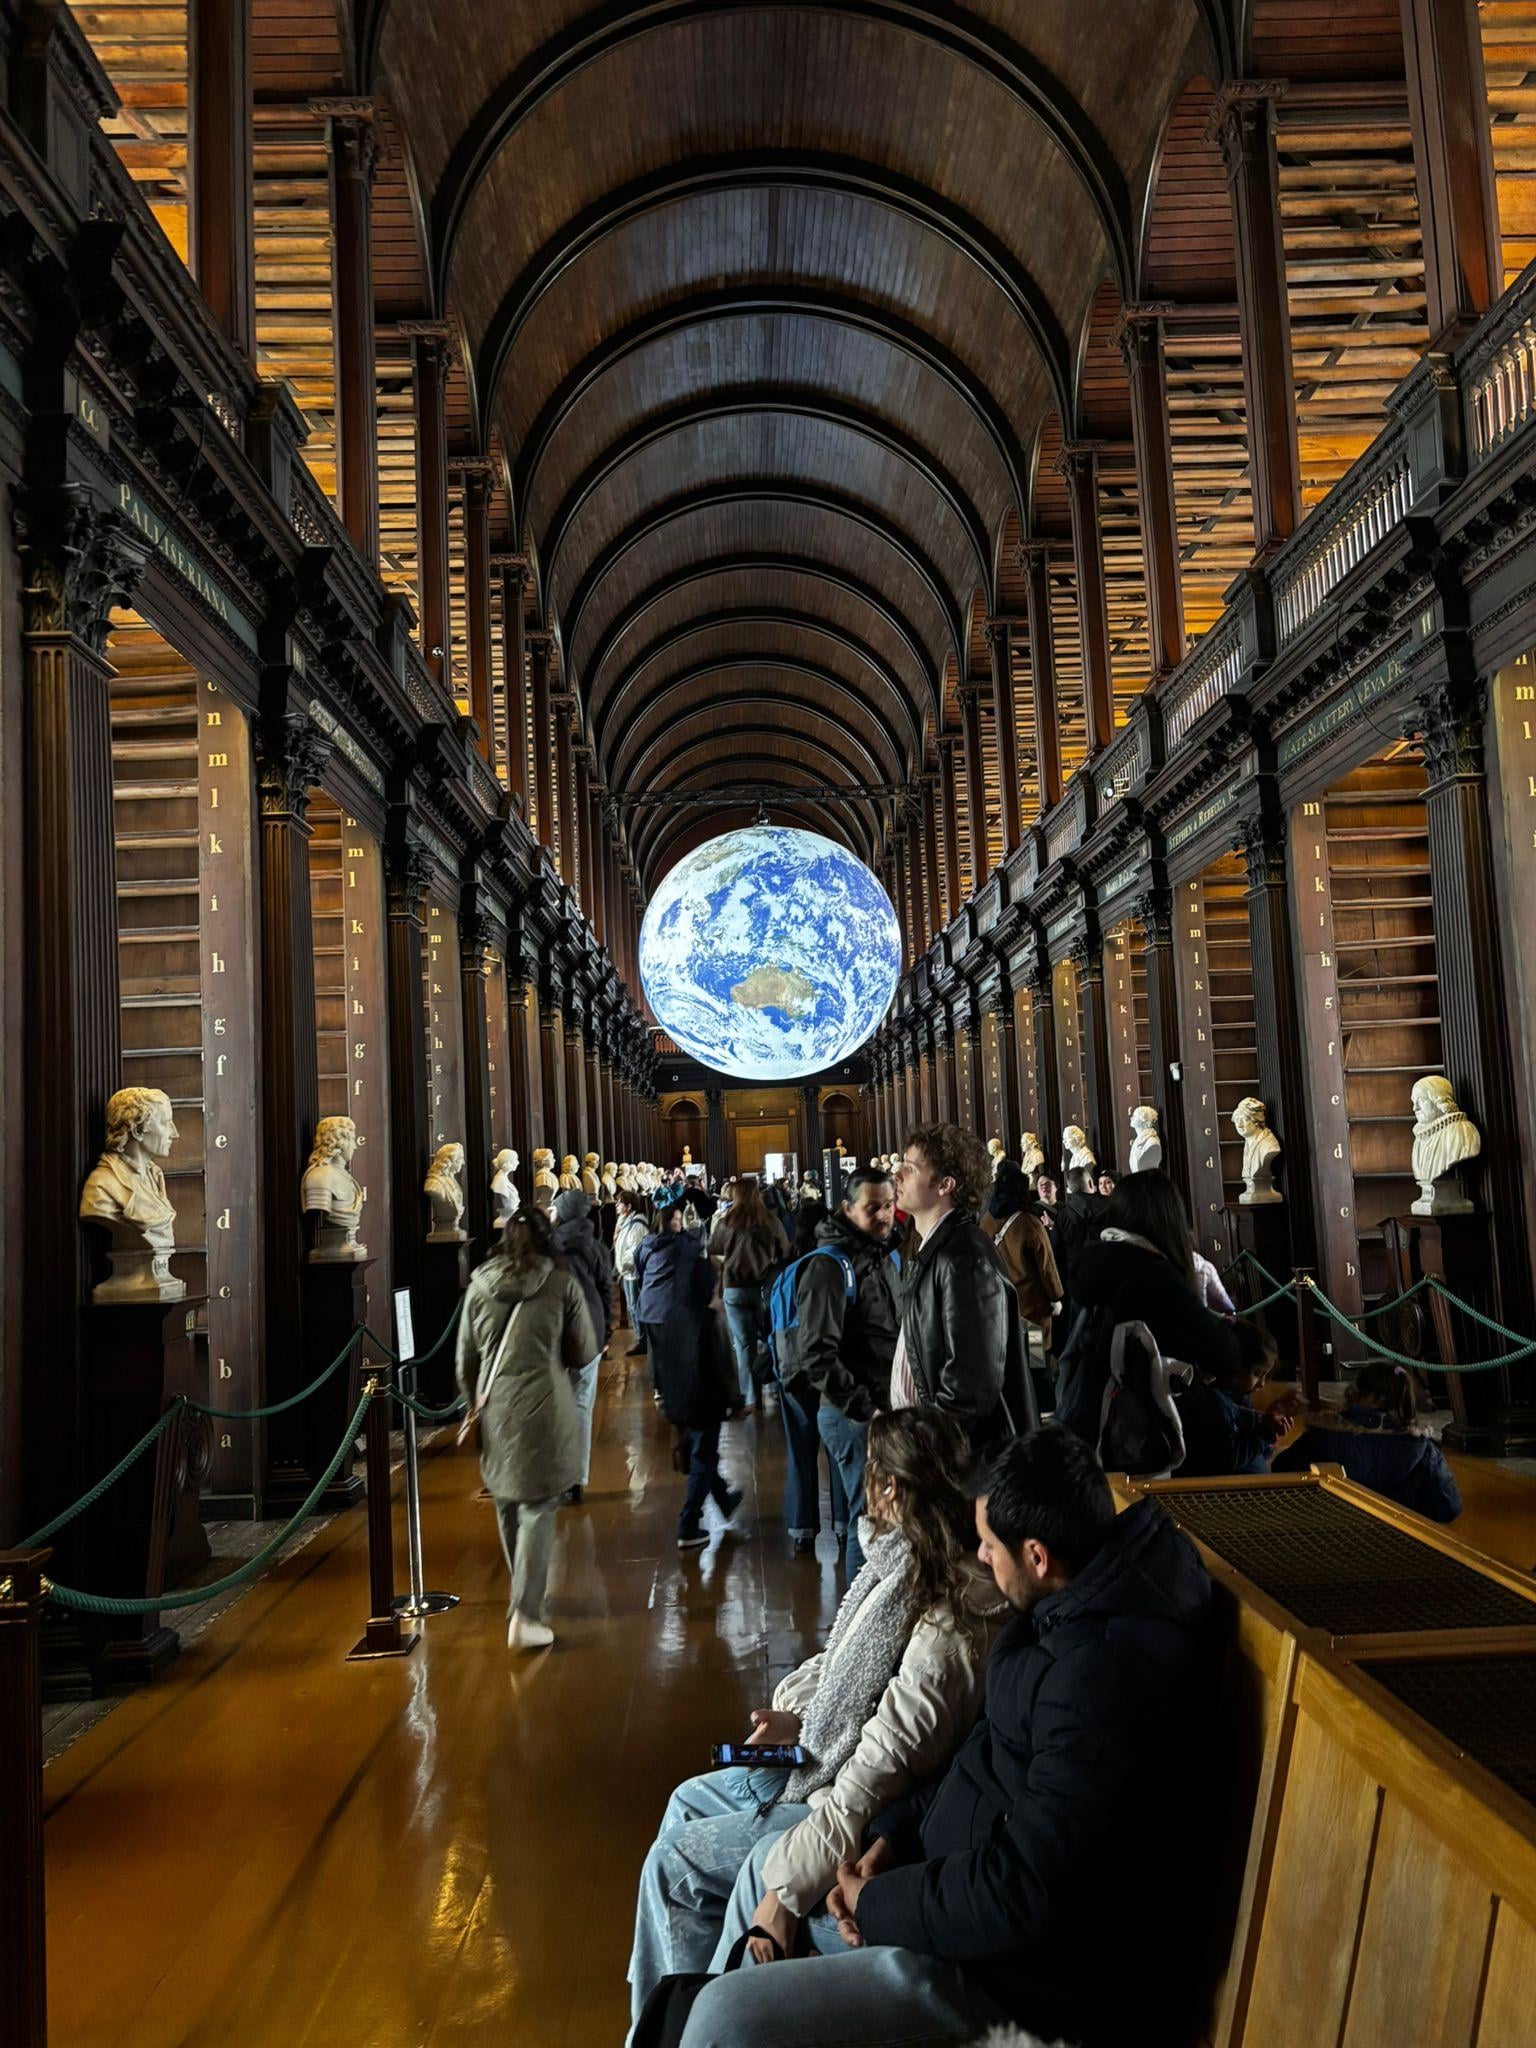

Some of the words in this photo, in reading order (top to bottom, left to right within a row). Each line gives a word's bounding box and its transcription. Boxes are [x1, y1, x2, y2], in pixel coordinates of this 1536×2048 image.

[1363, 676, 1386, 700] EVA
[1516, 686, 1534, 700] m
[208, 713, 221, 725] n
[1522, 720, 1531, 739] l
[209, 754, 227, 766] m
[211, 787, 218, 808] l
[1303, 803, 1319, 815] m
[347, 818, 356, 826] n
[210, 834, 222, 853] k
[348, 848, 363, 857] m
[1315, 845, 1320, 858] l
[349, 871, 355, 887] l
[1315, 877, 1324, 891] k
[1189, 882, 1196, 890] o
[211, 894, 218, 911] i
[1190, 903, 1197, 912] n
[431, 908, 439, 916] n
[1319, 912, 1324, 926] i
[352, 920, 363, 933] k
[431, 935, 441, 943] m
[431, 950, 436, 960] l
[1194, 951, 1199, 963] l
[1321, 951, 1330, 966] h
[212, 953, 225, 973] h
[352, 956, 359, 970] i
[433, 983, 441, 993] k
[1194, 980, 1202, 989] k
[353, 1000, 363, 1014] h
[1324, 996, 1332, 1009] g
[434, 1011, 439, 1022] i
[1197, 1006, 1202, 1016] i
[215, 1019, 225, 1035] g
[1197, 1028, 1205, 1040] h
[434, 1036, 442, 1048] h
[1327, 1041, 1335, 1055] f
[355, 1044, 365, 1058] g
[217, 1055, 226, 1075] f
[354, 1079, 362, 1095] f
[435, 1094, 441, 1105] f
[1202, 1094, 1207, 1105] f
[1331, 1094, 1339, 1105] e
[437, 1133, 444, 1141] e
[1204, 1127, 1211, 1135] e
[215, 1135, 227, 1148] e
[356, 1136, 365, 1145] e
[1333, 1143, 1342, 1158] d
[1205, 1156, 1213, 1167] d
[1340, 1206, 1348, 1217] c
[217, 1209, 229, 1229] d
[1213, 1239, 1221, 1250] b
[1346, 1262, 1355, 1275] b
[220, 1286, 229, 1297] c
[218, 1359, 231, 1378] b
[221, 1435, 231, 1447] a
